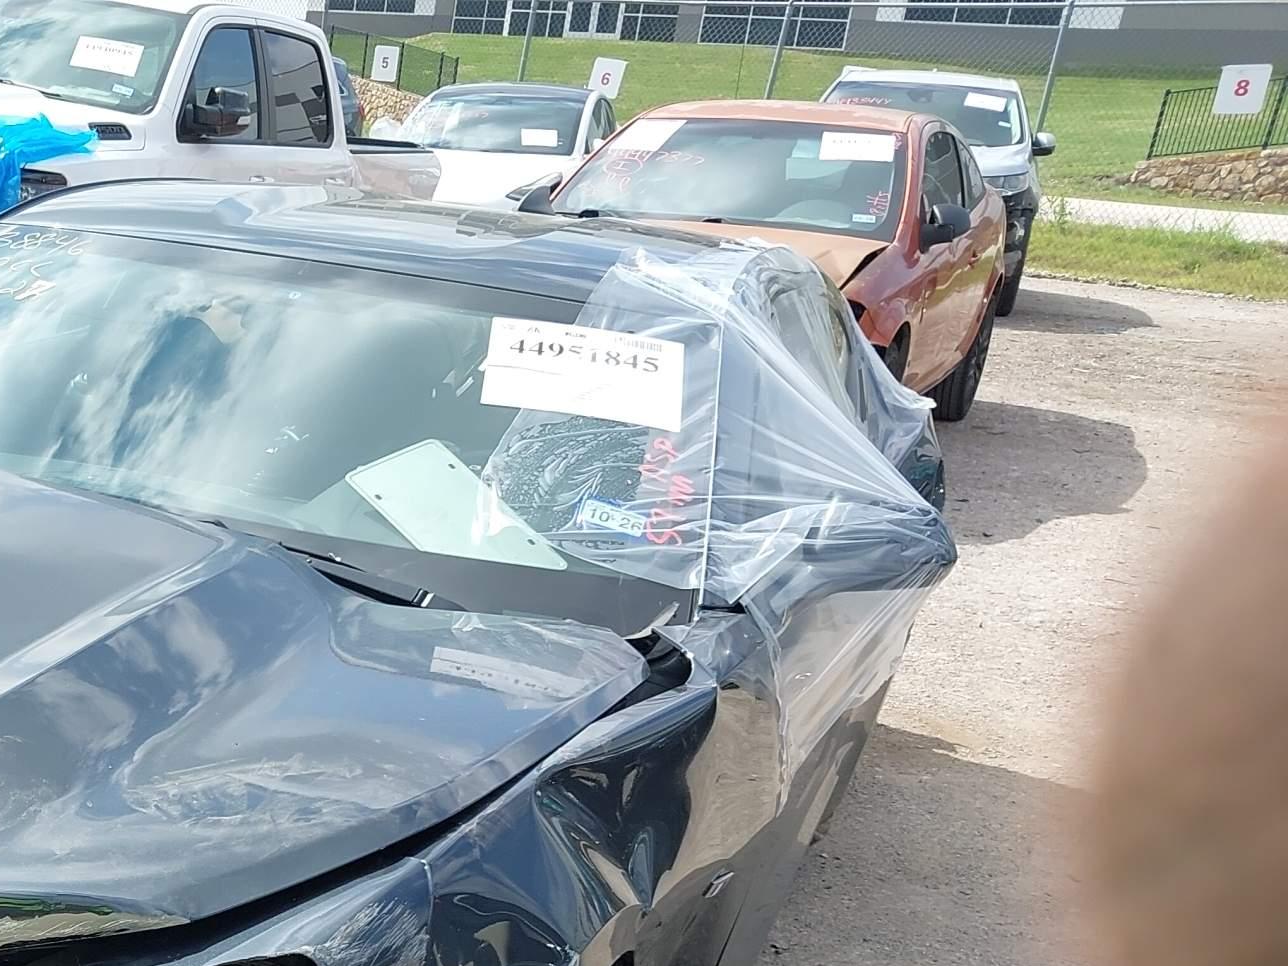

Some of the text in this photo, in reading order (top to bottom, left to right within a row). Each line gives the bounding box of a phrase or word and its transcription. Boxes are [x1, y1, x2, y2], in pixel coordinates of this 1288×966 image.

[381, 56, 390, 69] 5
[601, 72, 612, 86] 6
[1234, 79, 1250, 97] 8
